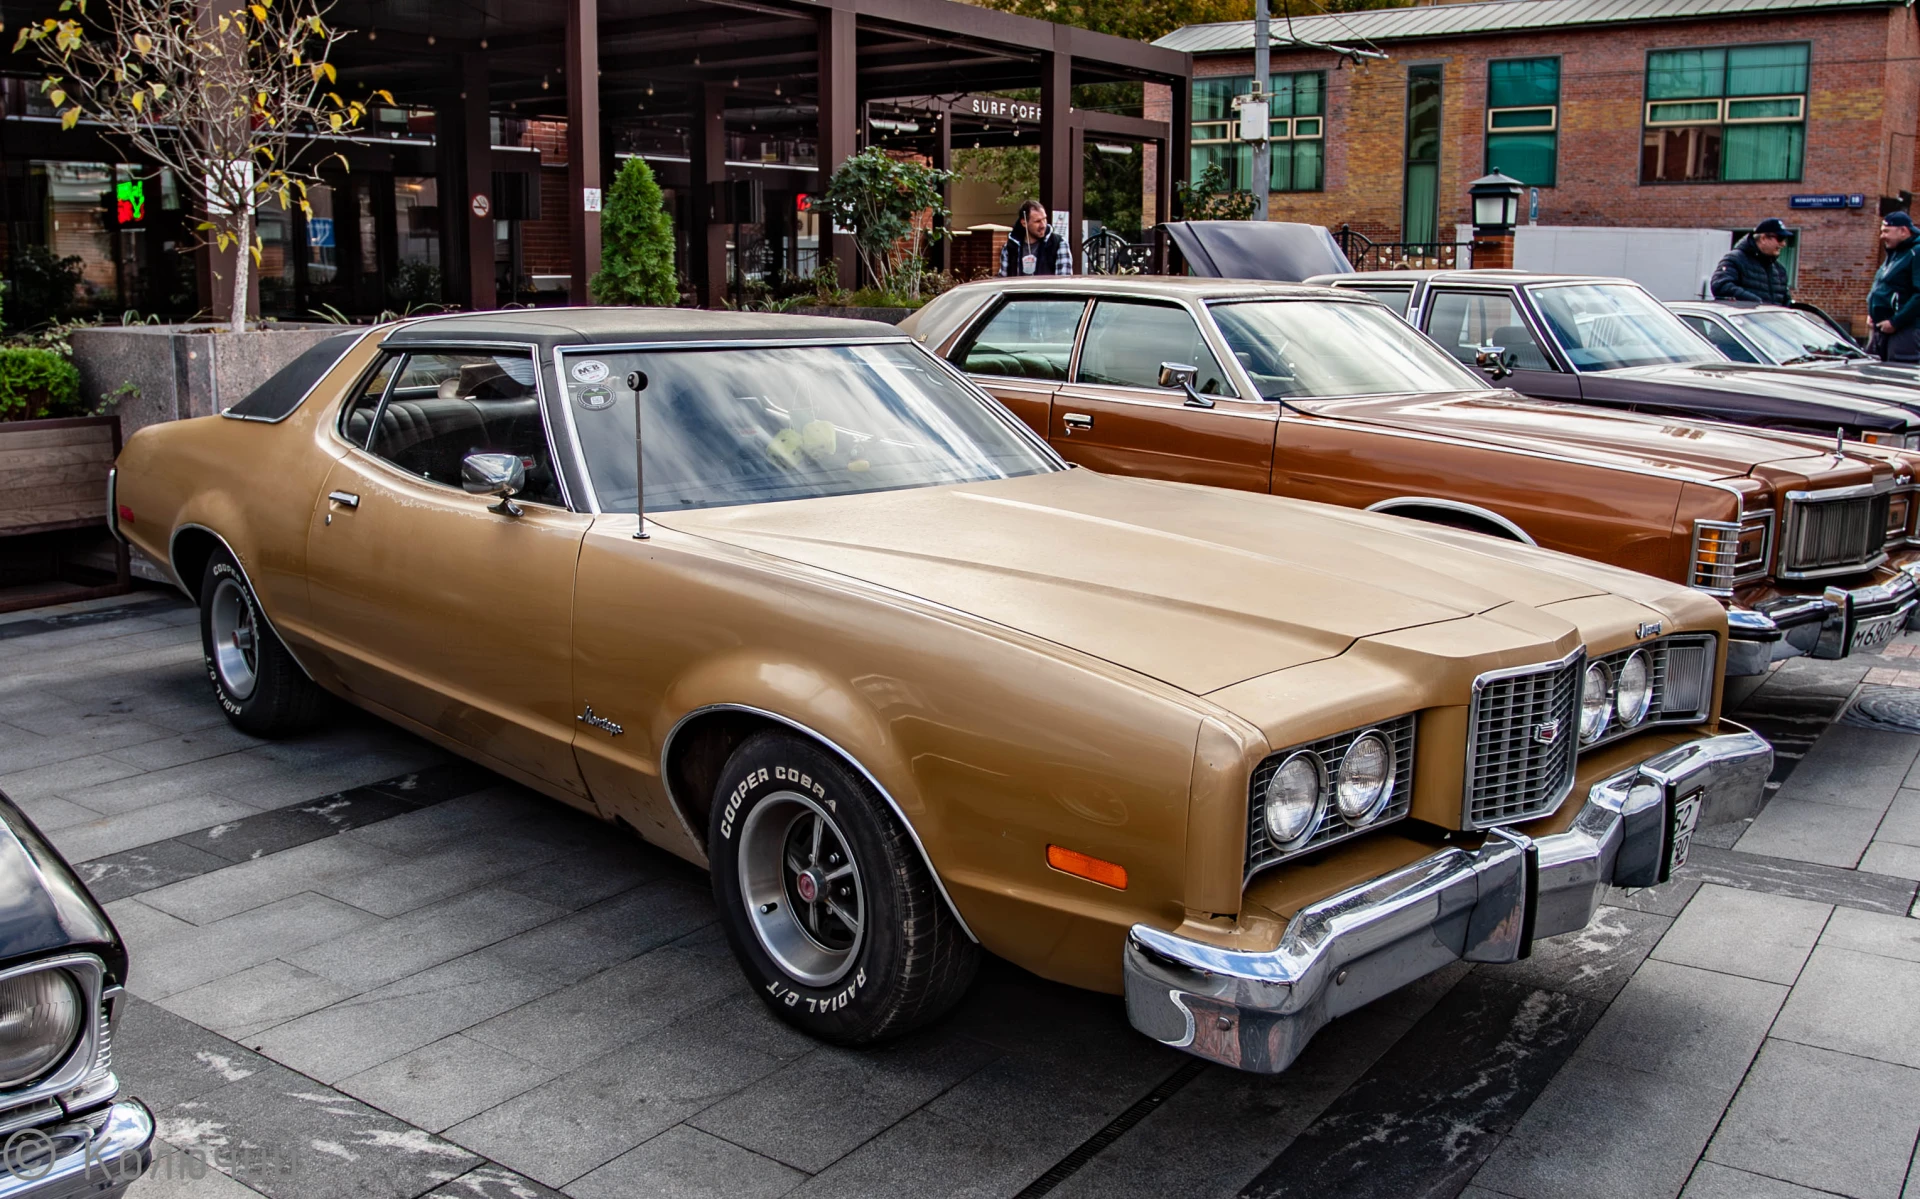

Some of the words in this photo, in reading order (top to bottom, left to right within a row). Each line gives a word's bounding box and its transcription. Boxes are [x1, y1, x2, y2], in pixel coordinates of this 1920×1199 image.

[973, 99, 1006, 114] SURF
[720, 767, 769, 839] COOPER
[775, 766, 838, 813] COBRA
[766, 981, 800, 1007] G/T
[806, 967, 867, 1013] RADIAL
